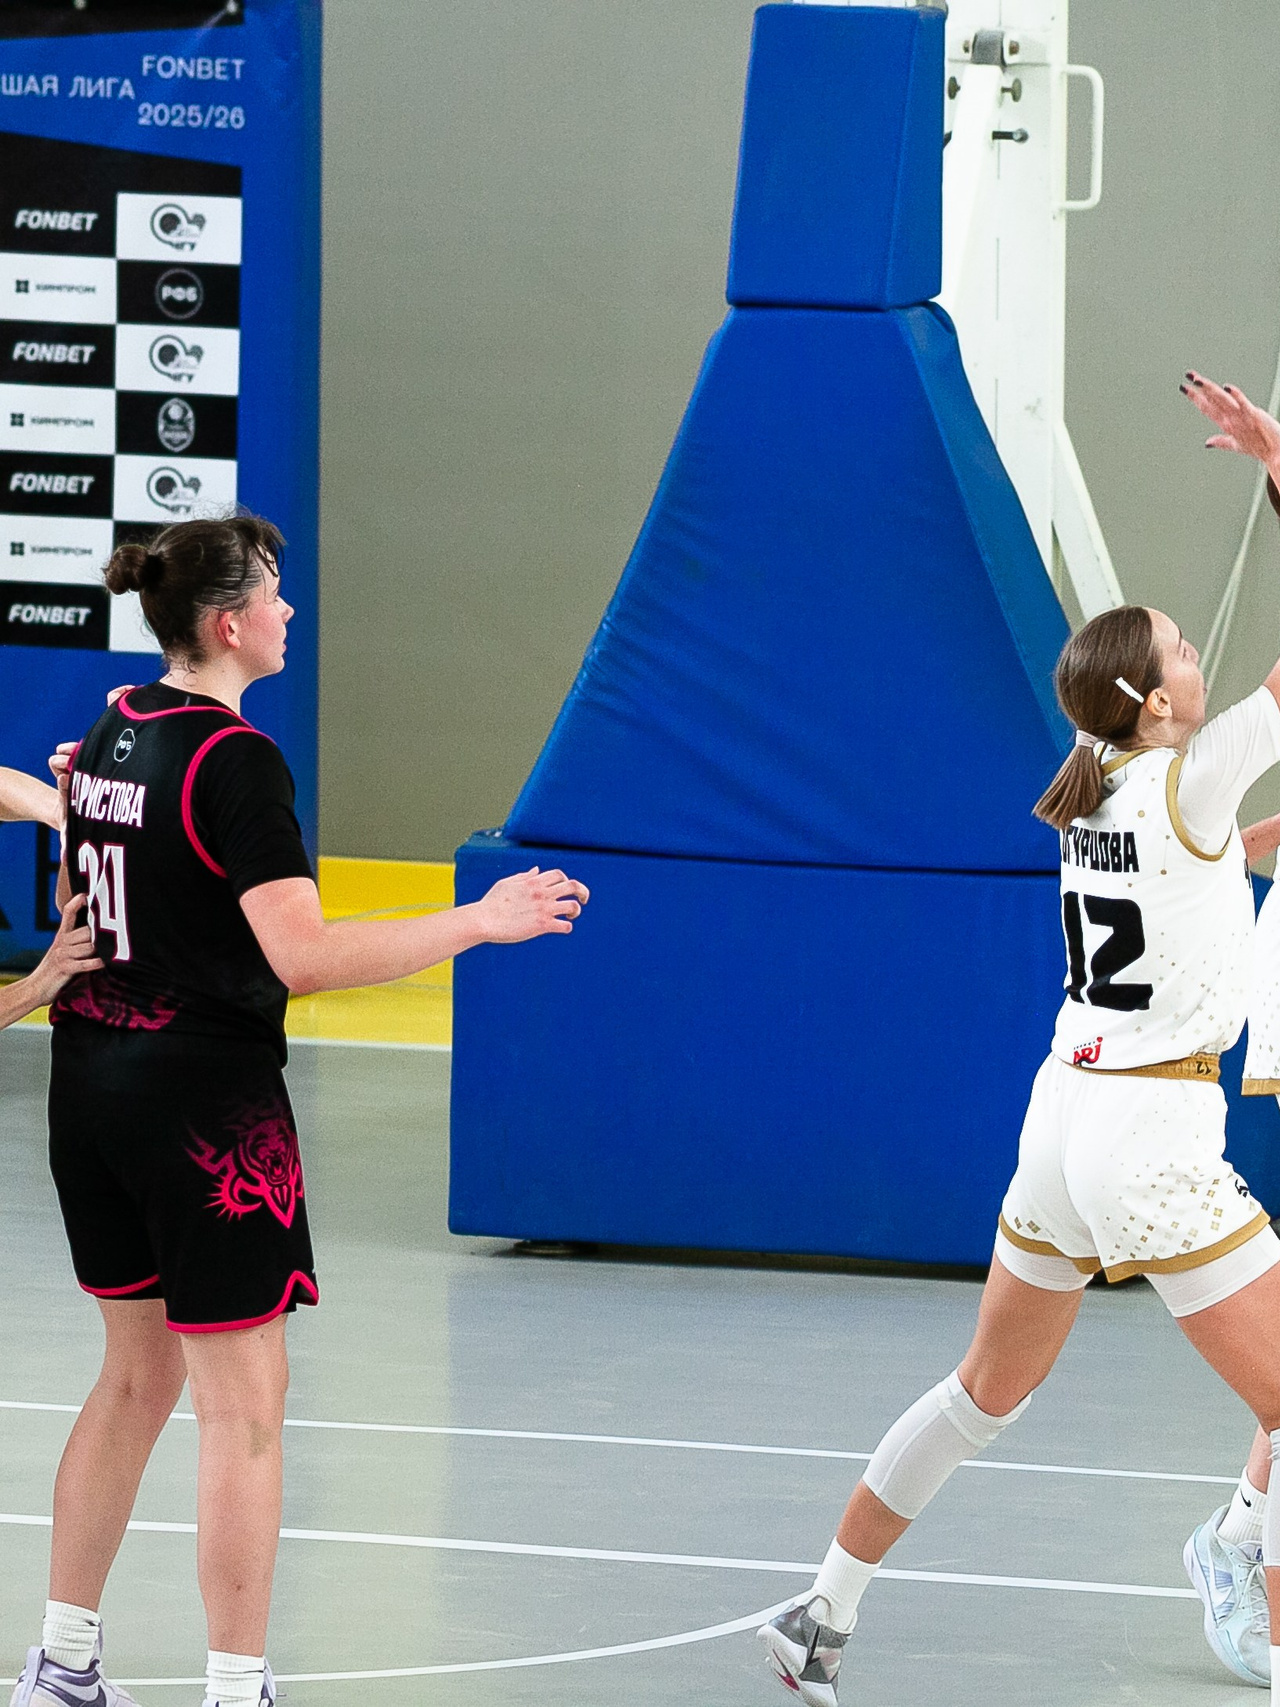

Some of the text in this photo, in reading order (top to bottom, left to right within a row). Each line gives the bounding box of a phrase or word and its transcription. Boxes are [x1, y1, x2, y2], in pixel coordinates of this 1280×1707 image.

[142, 55, 245, 80] FONBET
[69, 76, 136, 100] ЛИГА
[138, 102, 245, 130] 2025/26
[15, 209, 98, 231] FONBET
[12, 342, 96, 364] FONBET
[9, 473, 94, 495] FONBET
[8, 604, 92, 626] FONBET
[1063, 891, 1154, 1012] 12
